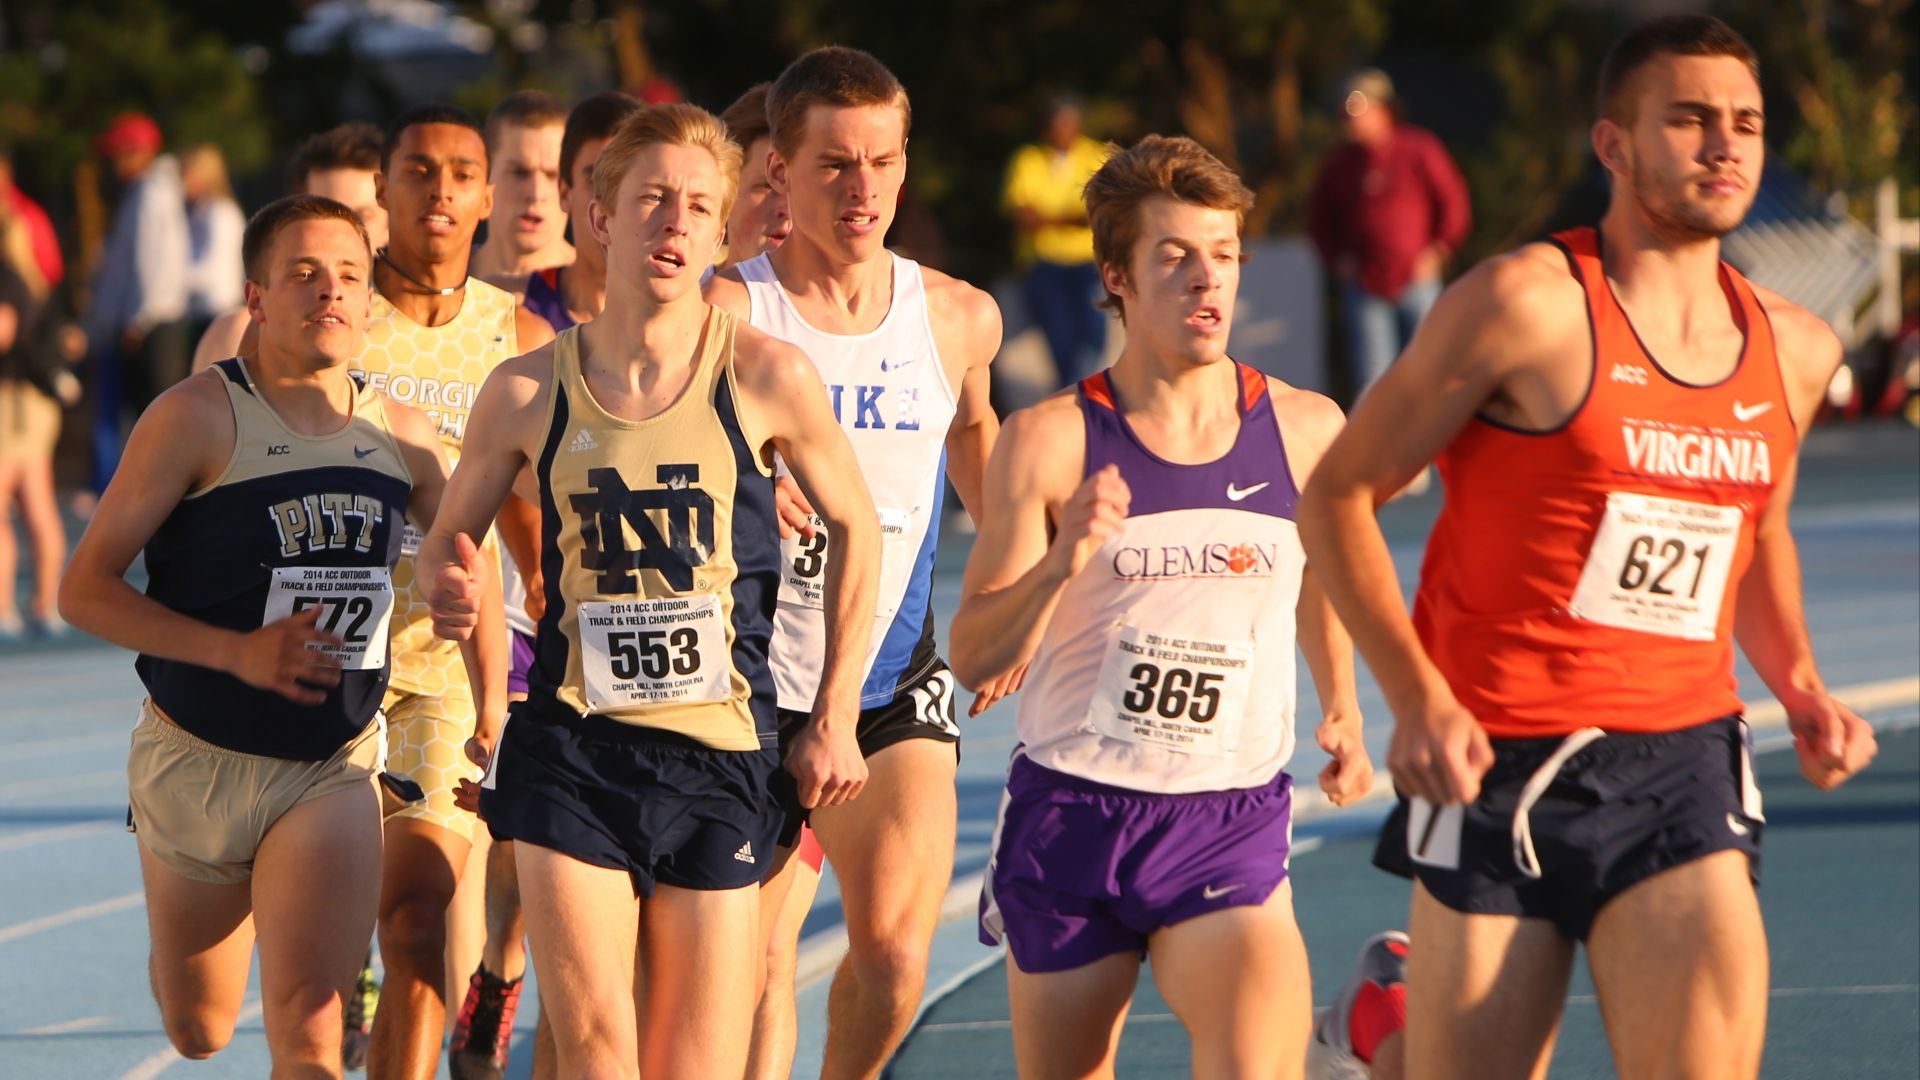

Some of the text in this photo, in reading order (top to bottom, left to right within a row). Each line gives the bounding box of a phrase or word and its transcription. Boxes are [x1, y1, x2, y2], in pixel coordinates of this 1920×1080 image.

[267, 444, 290, 456] ACC
[1622, 425, 1772, 484] VIRGINIA
[268, 493, 384, 558] PITT
[303, 570, 371, 580] 2014 ACC OUTDOOR
[1618, 535, 1712, 599] 621
[281, 582, 388, 592] TRACK & FIELD CHAMPIONSHIPS
[610, 600, 689, 614] 2014 ACC OUTDOOR
[589, 609, 714, 626] TRACK & FIELD CHAMPIONSHIPS
[607, 627, 701, 680] 553
[612, 683, 635, 691] CHAPEL
[653, 681, 673, 690] NORTH
[674, 676, 704, 688] CAROLINA
[671, 689, 688, 698] 2014
[1123, 662, 1225, 723] 365
